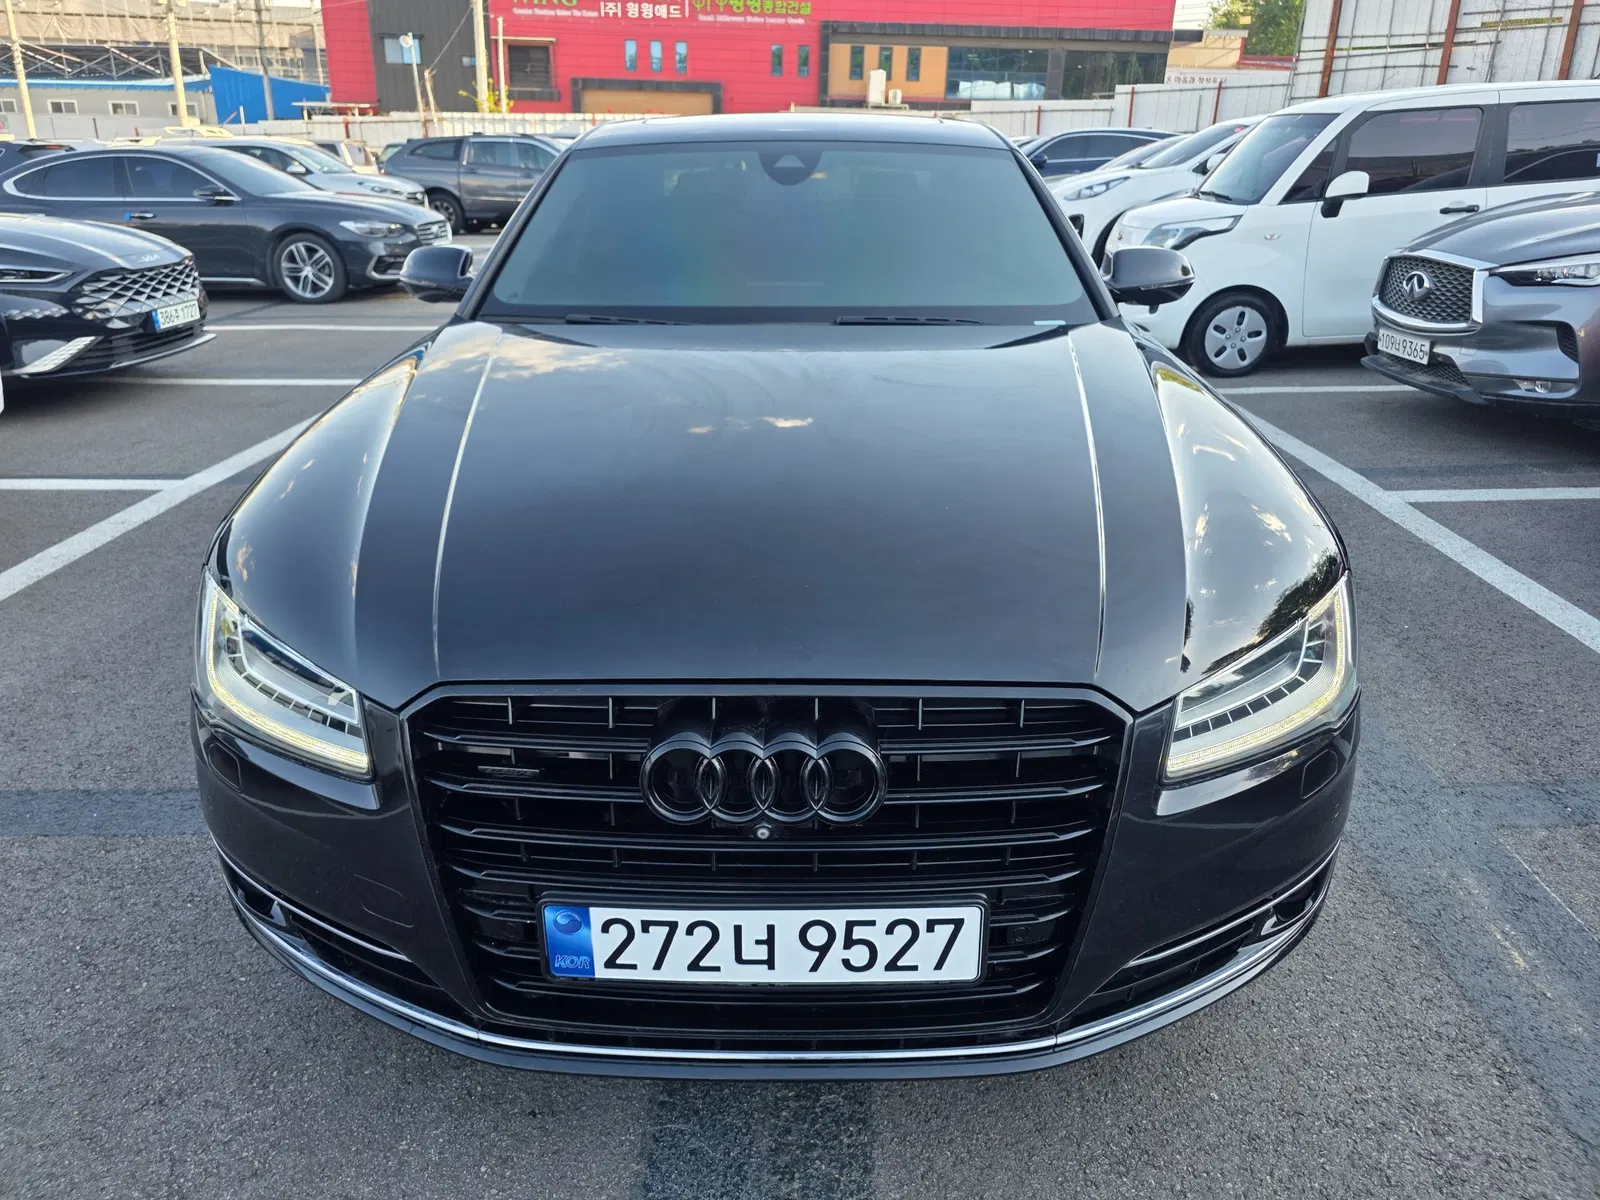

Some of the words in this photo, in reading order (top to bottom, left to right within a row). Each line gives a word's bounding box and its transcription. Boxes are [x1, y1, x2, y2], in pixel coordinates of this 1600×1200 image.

[1402, 338, 1426, 361] 9365
[600, 917, 776, 973] 272너
[798, 917, 966, 973] 9527
[554, 954, 591, 970] KOR
